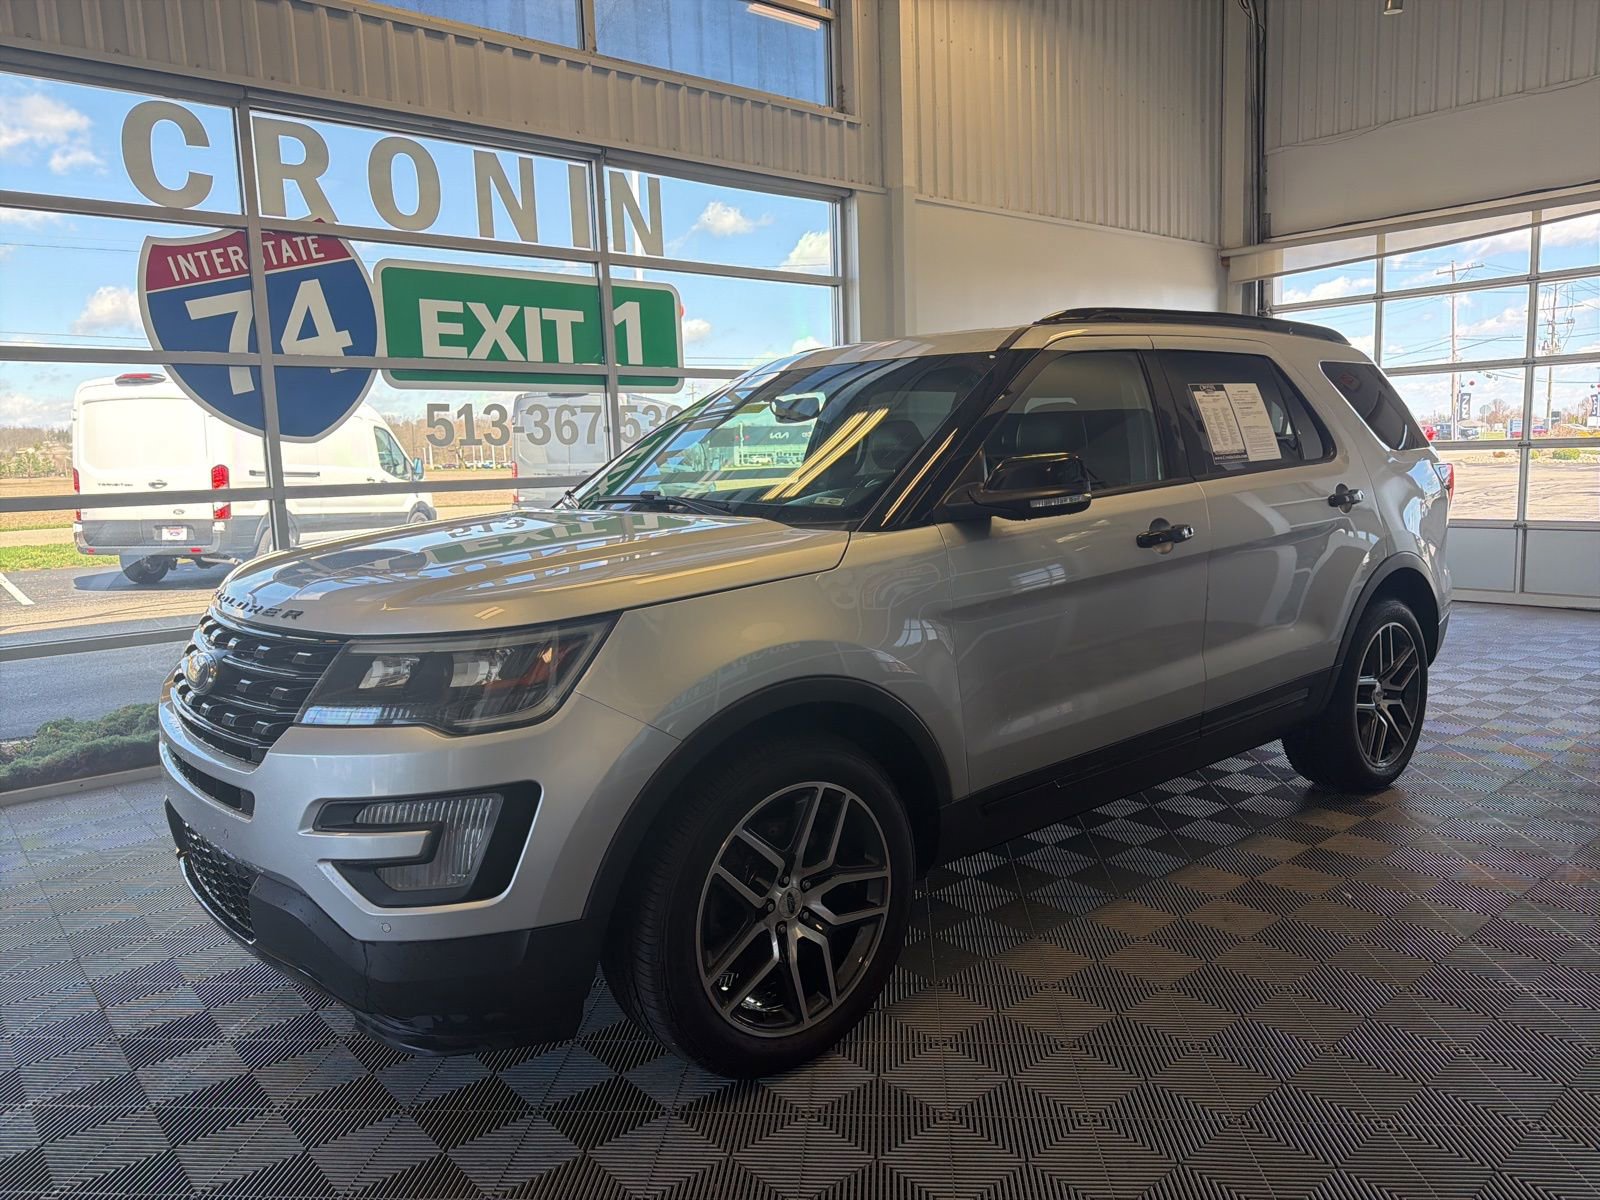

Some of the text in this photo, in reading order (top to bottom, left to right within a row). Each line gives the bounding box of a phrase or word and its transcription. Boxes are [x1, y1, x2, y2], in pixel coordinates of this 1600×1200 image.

[121, 99, 663, 257] CRONIN
[166, 236, 325, 282] INTERTATE
[184, 278, 353, 395] 74
[418, 298, 644, 365] EXIT 1
